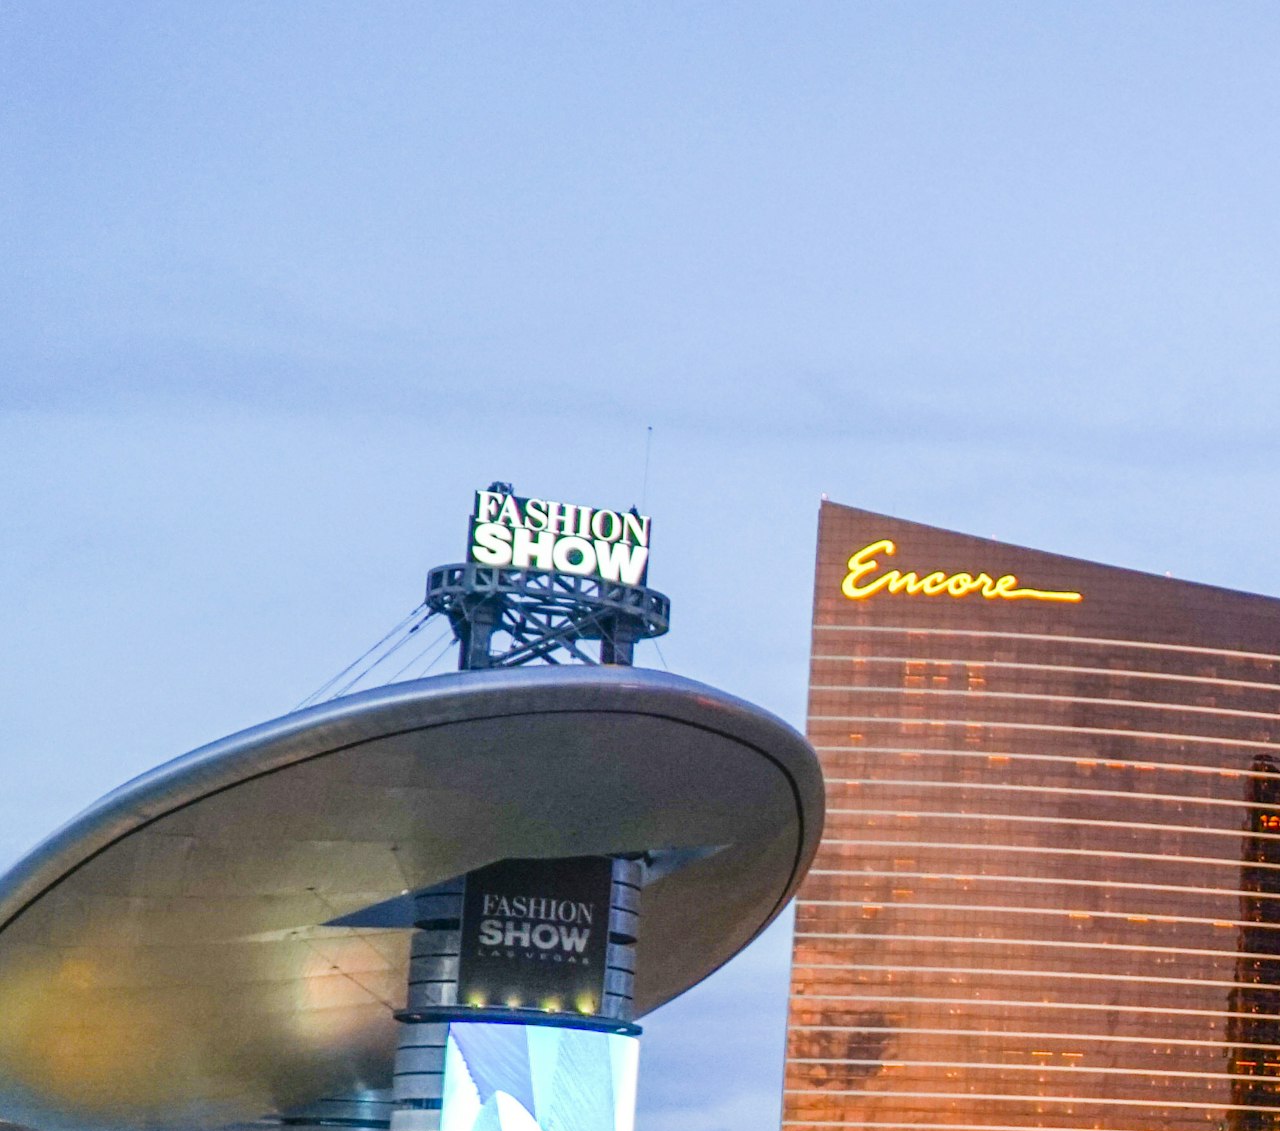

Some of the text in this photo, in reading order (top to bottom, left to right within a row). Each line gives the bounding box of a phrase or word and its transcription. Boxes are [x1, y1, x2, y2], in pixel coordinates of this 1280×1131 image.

[475, 489, 652, 547] FASHION
[471, 522, 651, 586] SHOW
[841, 538, 1084, 602] Encore
[483, 894, 594, 924] FASHION
[479, 919, 590, 953] SHOW
[479, 950, 589, 965] LAS VEGAS
